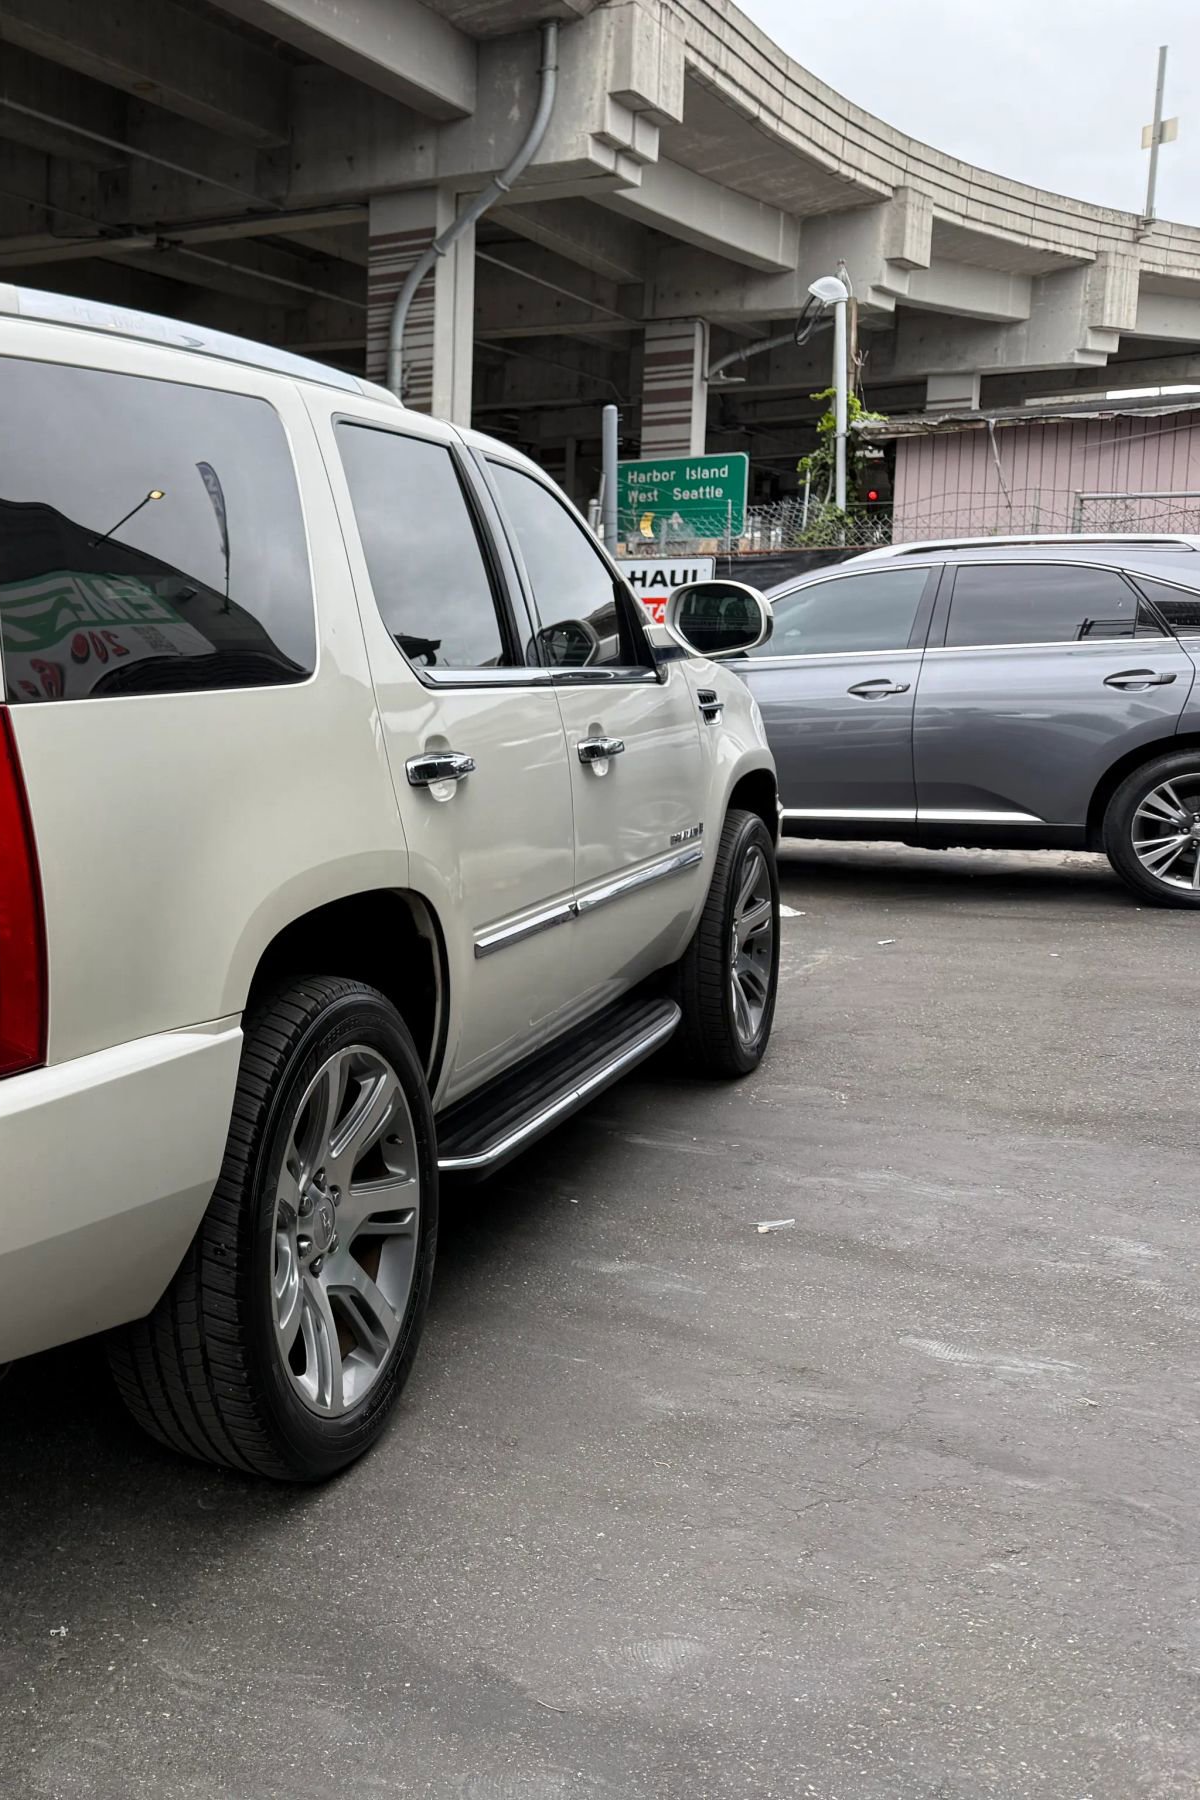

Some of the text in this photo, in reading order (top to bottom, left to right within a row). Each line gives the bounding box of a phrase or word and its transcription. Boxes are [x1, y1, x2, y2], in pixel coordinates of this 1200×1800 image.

[627, 464, 729, 484] Harbor Island
[627, 485, 724, 503] West Seattle
